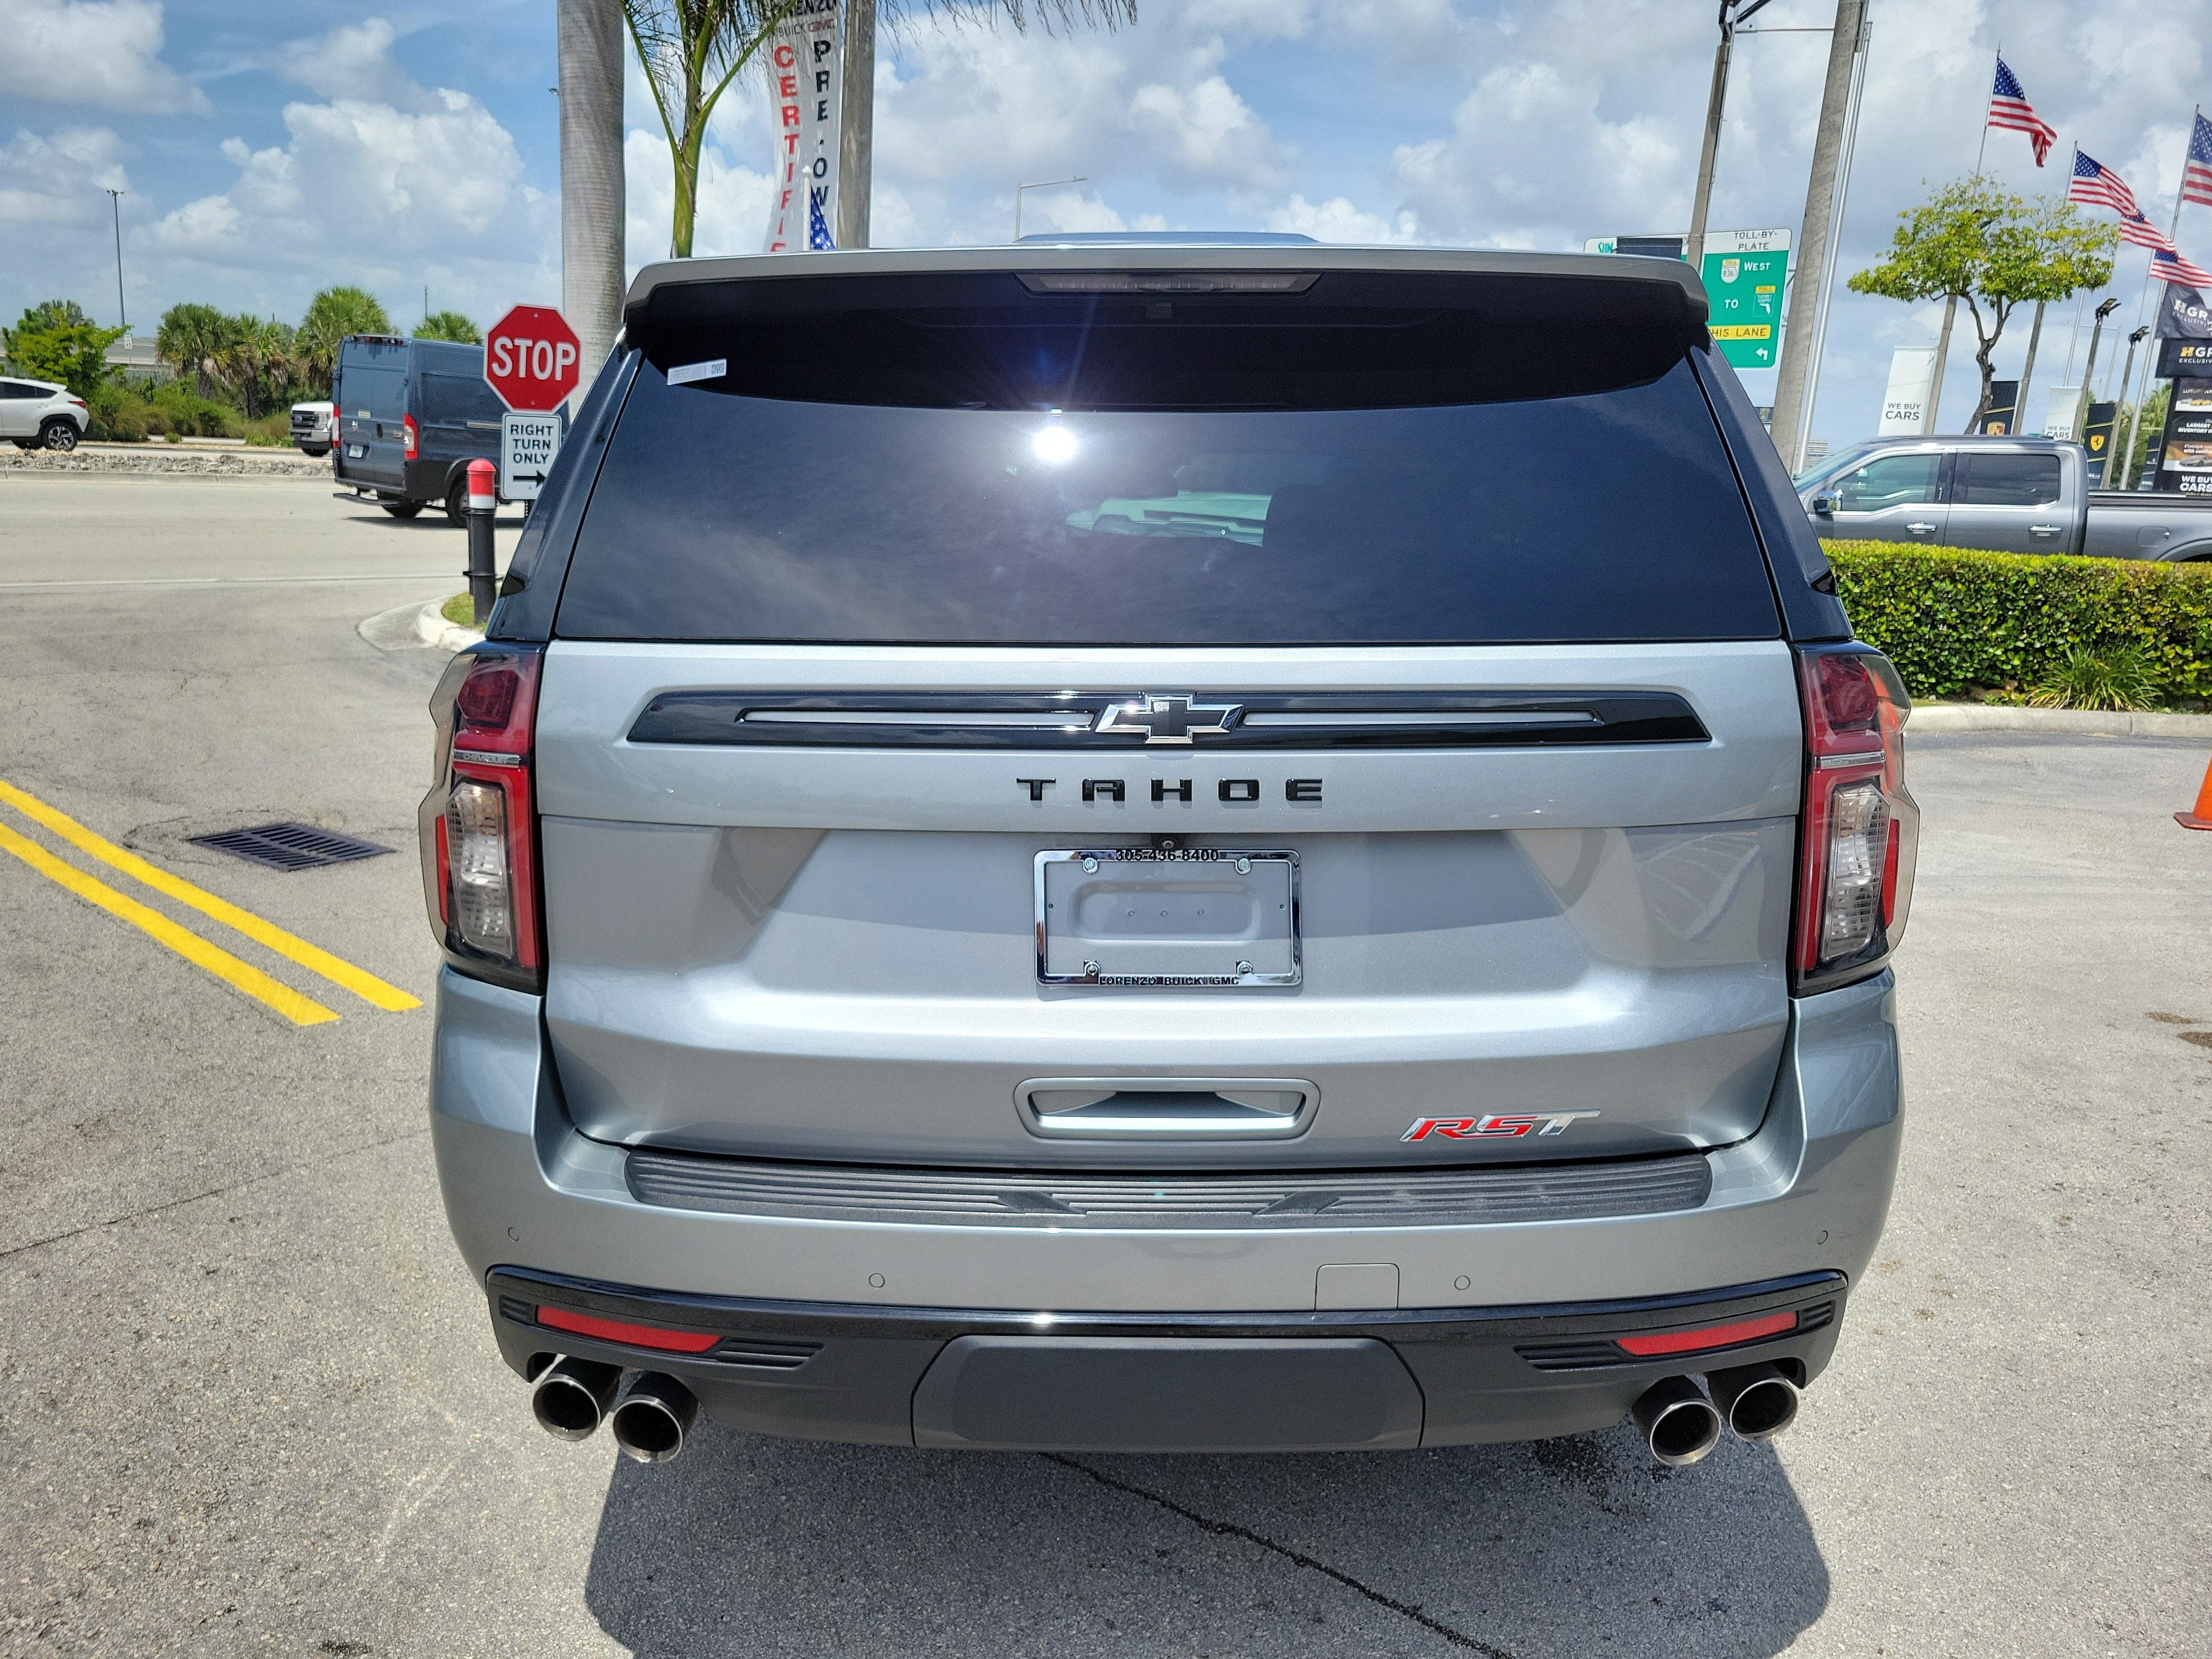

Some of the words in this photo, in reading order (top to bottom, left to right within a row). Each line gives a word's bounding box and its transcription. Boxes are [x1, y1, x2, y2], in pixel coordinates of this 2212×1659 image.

[812, 40, 832, 208] PRE-OW
[1734, 230, 1778, 239] TOLL-BY-
[1738, 242, 1769, 251] PLATE
[1724, 298, 1739, 309] TO
[1710, 327, 1729, 337] HIS
[1736, 328, 1767, 337] LANE
[492, 336, 577, 381] STOP
[1886, 411, 1920, 421] CARS
[510, 425, 554, 437] RIGHT
[513, 438, 551, 449] TURN
[513, 452, 549, 465] ONLY
[2180, 482, 2212, 493] CARS
[1016, 777, 1323, 802] TAHOE
[1115, 849, 1219, 861] 305-436-8400
[1099, 976, 1157, 985] LORENZO
[1164, 976, 1204, 985] BUICK
[1212, 976, 1240, 985] GMC
[1400, 1108, 1601, 1142] RST
